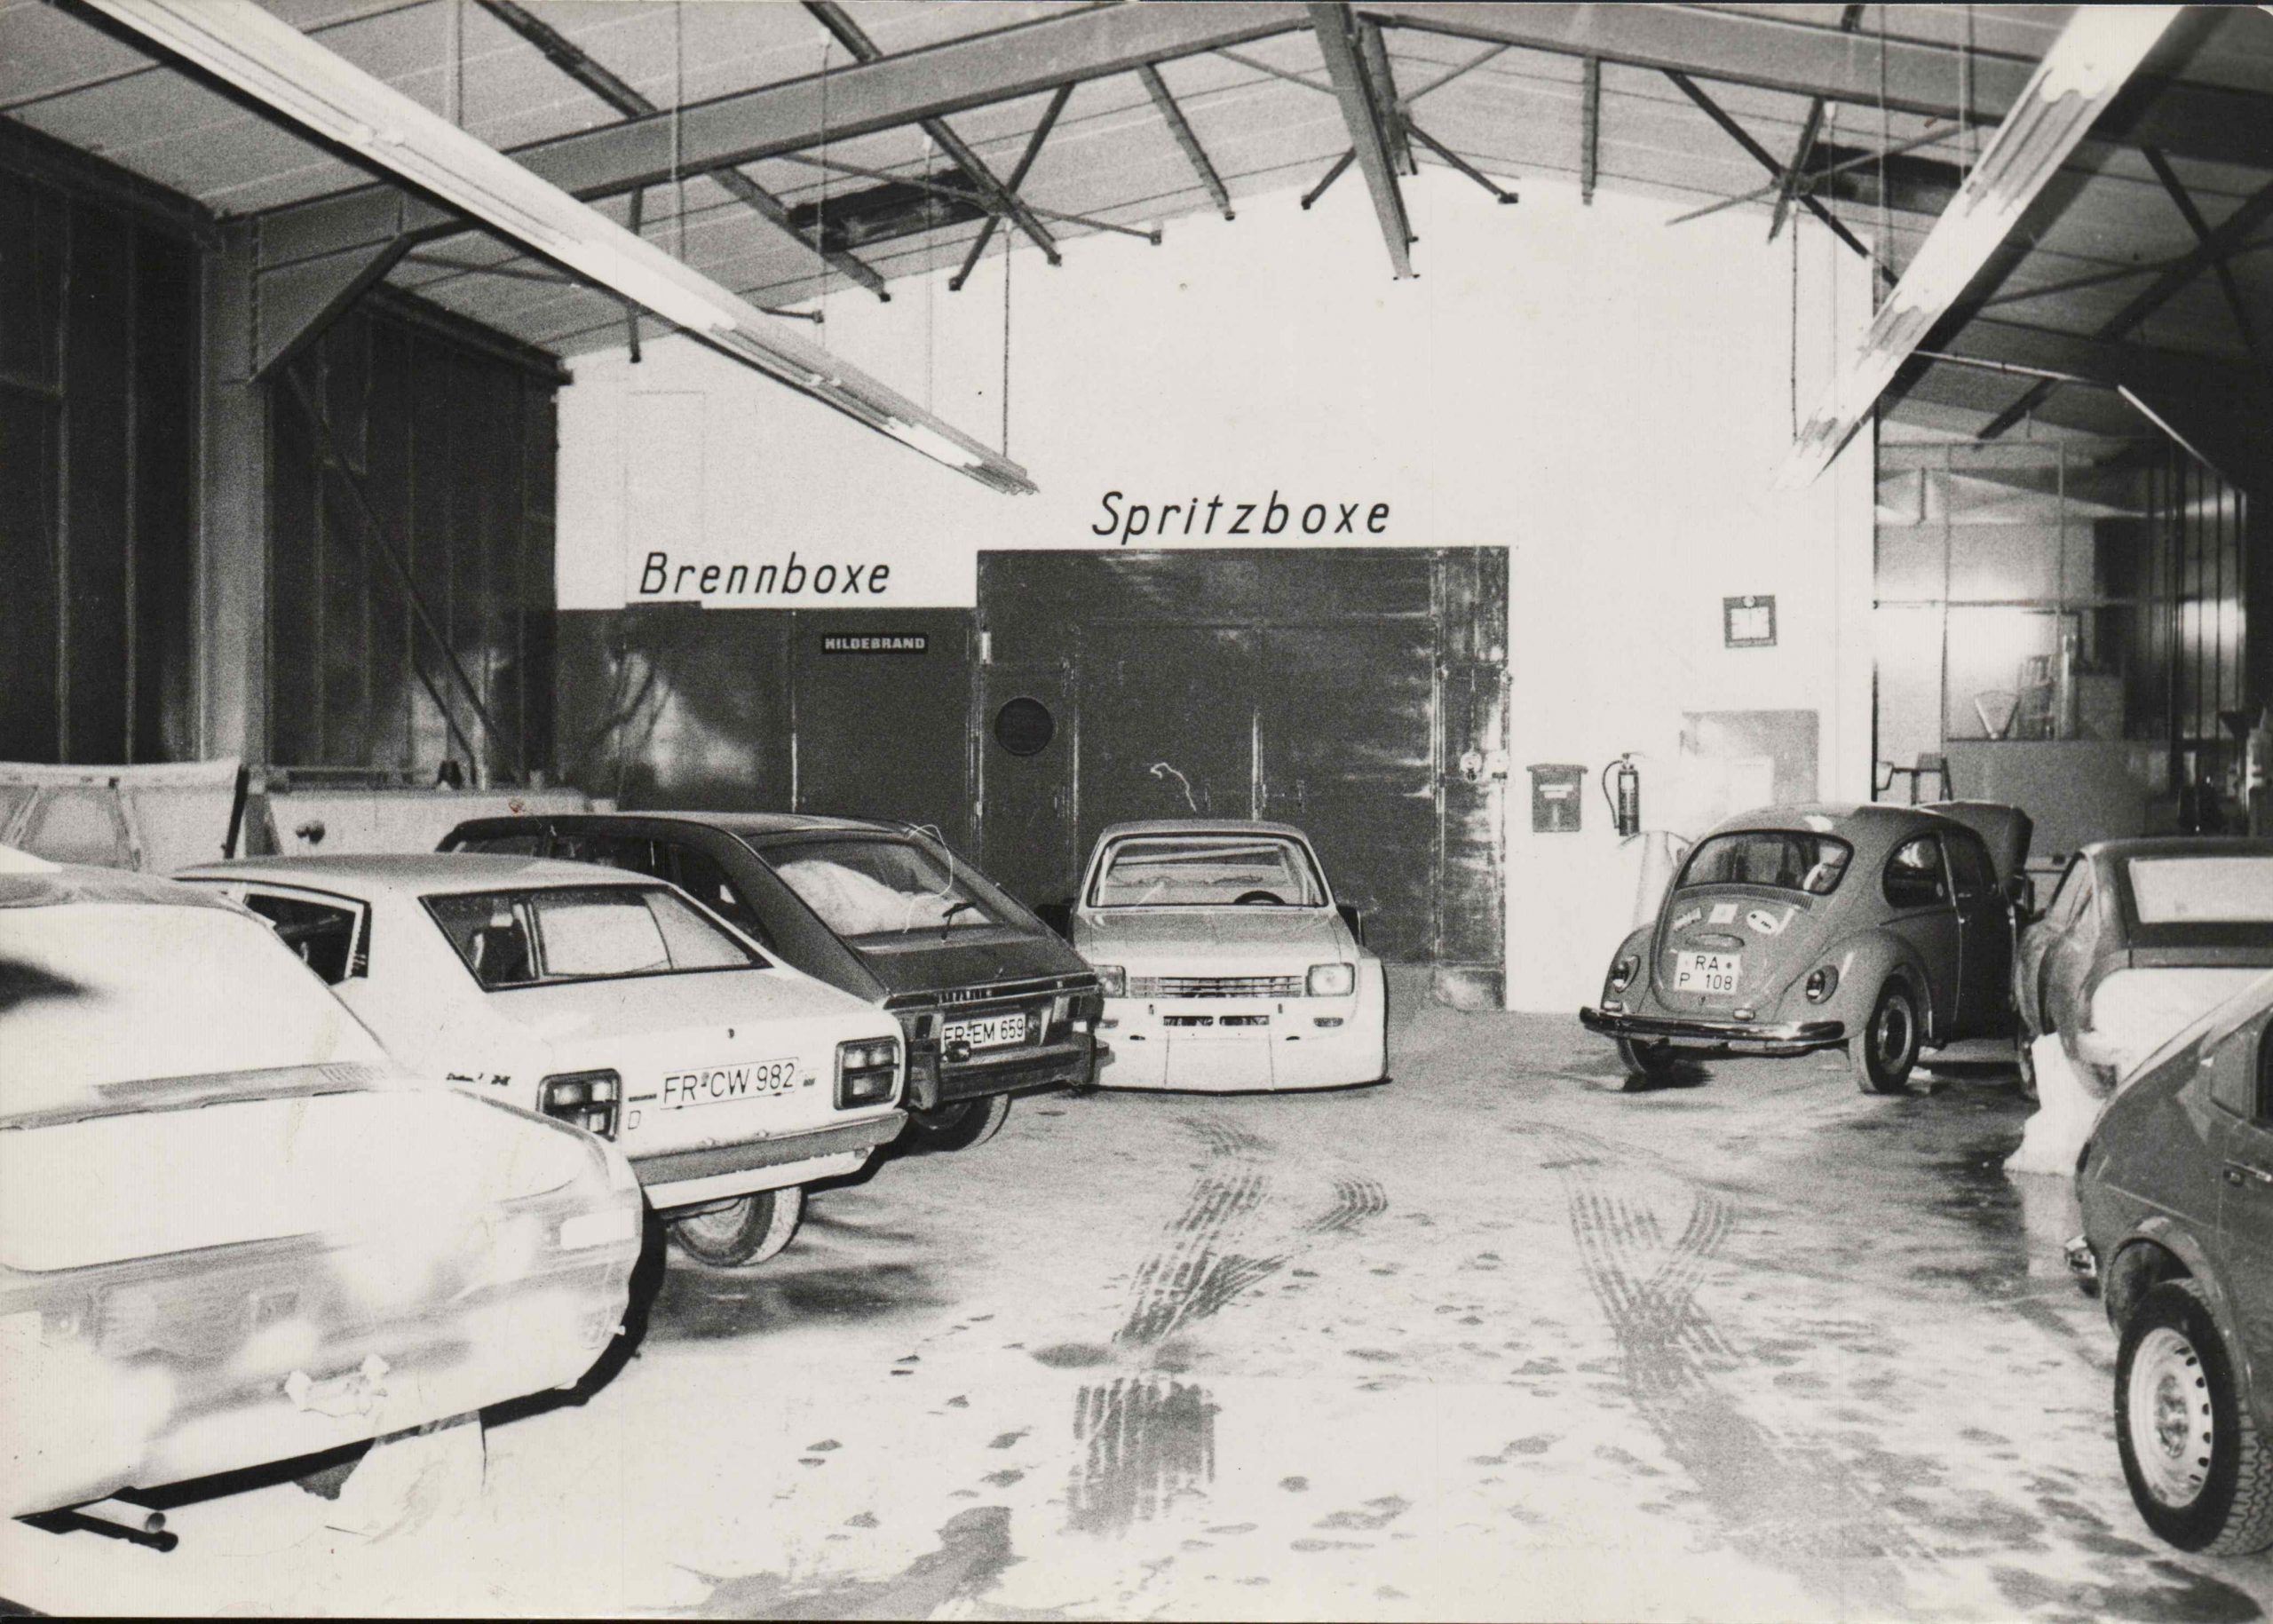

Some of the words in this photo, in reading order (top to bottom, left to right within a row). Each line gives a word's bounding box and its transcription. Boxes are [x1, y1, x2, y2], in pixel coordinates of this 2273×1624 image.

[1091, 489, 1390, 546] Spritzboxe
[638, 551, 891, 596] Brennboxe
[825, 638, 925, 650] HILDEBRAND
[1695, 955, 1719, 971] RA
[1679, 971, 1691, 987] P
[1706, 973, 1733, 991] 108
[1001, 1018, 1024, 1040] 659
[756, 1062, 796, 1092] 982
